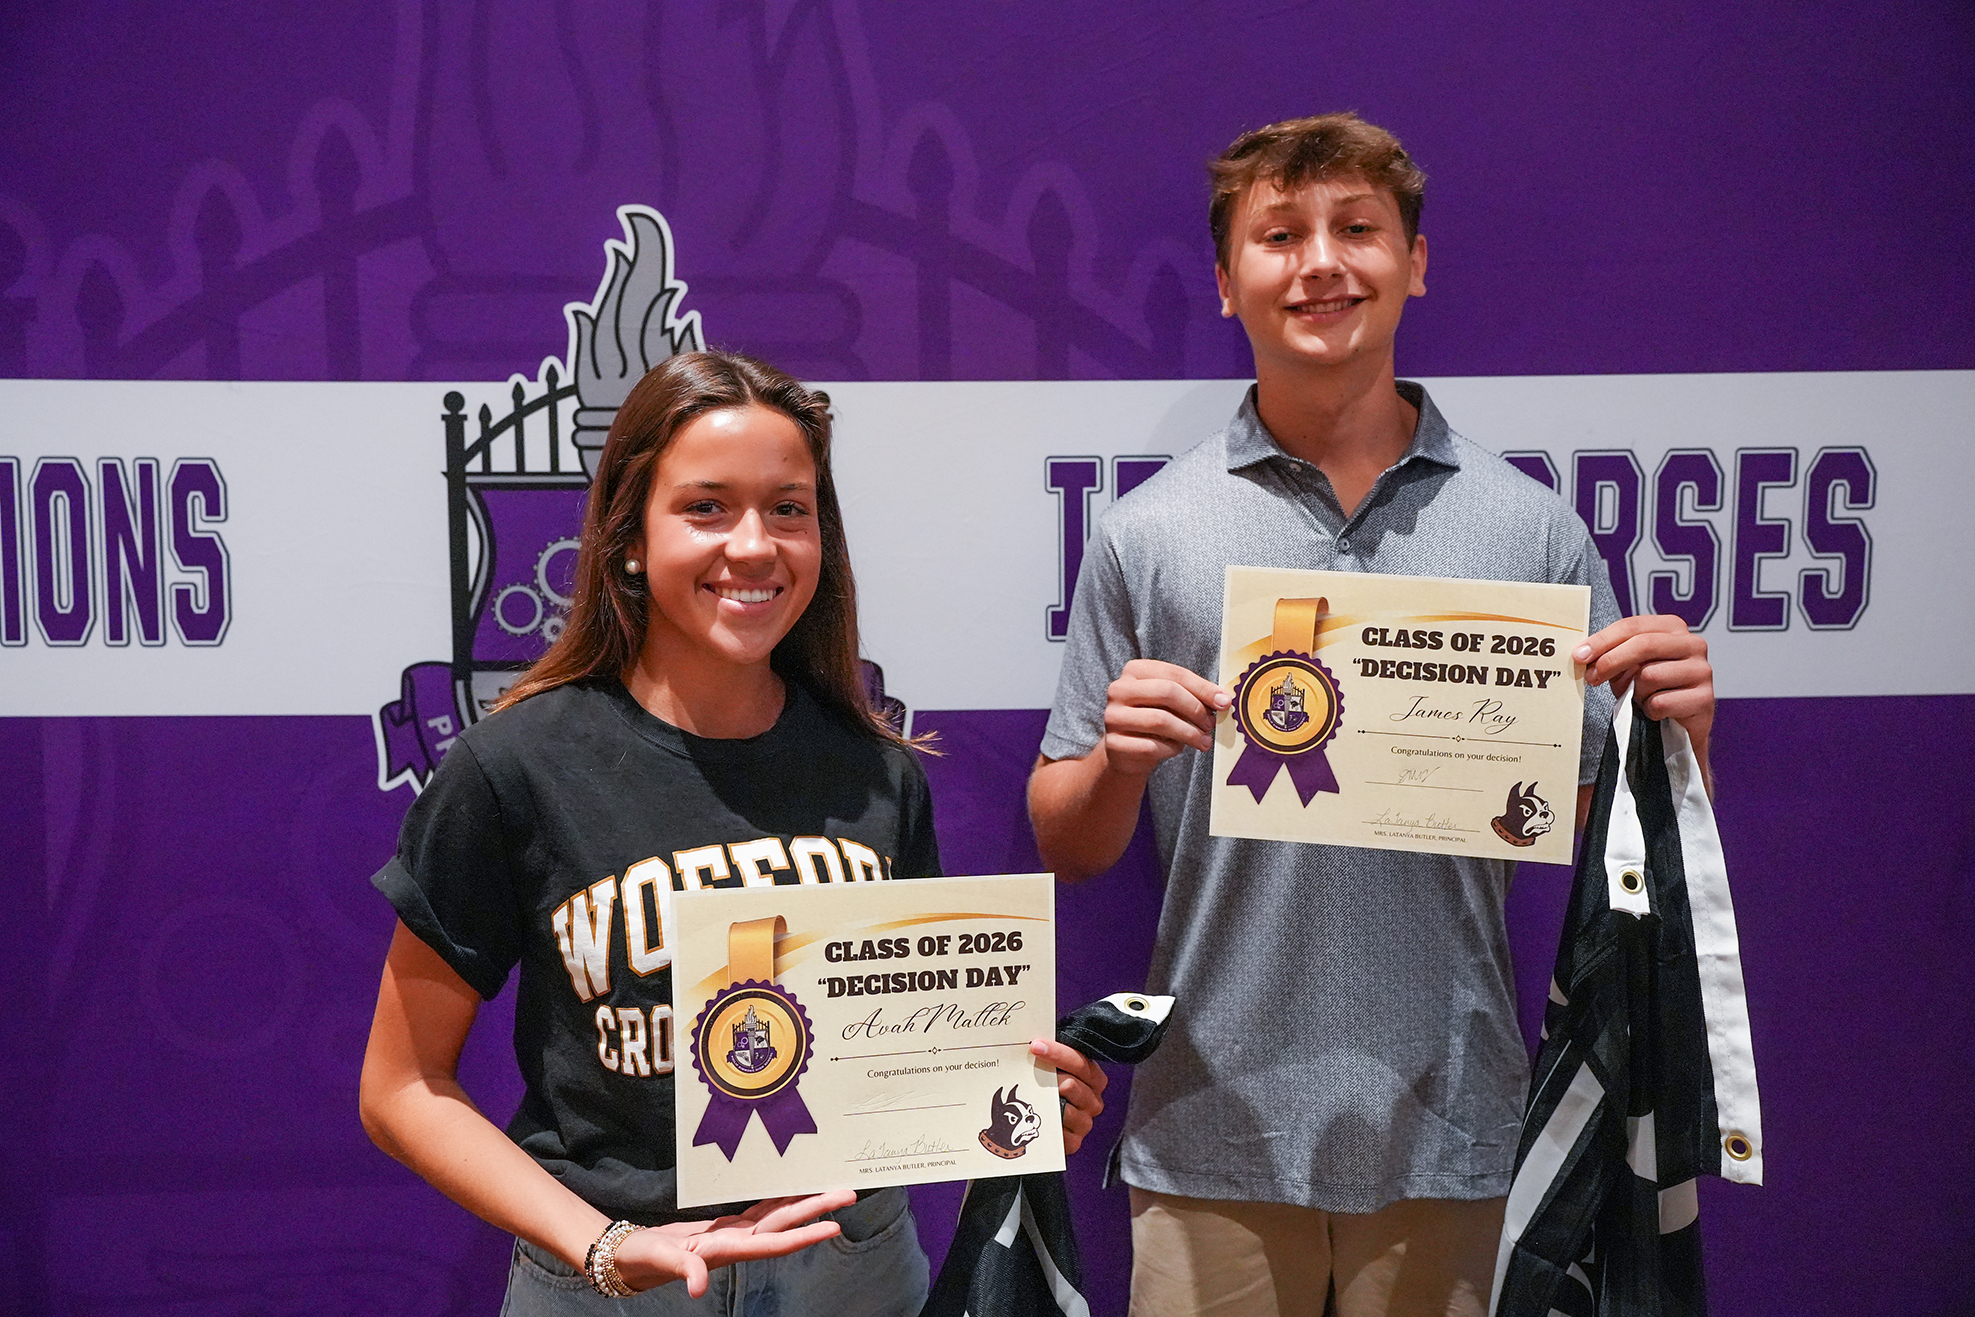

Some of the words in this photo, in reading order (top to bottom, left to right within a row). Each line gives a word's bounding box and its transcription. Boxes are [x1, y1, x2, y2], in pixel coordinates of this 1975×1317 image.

[0, 456, 232, 647] IONS
[1362, 627, 1443, 650] CLASS
[1450, 633, 1484, 652] OF
[1490, 635, 1555, 657] 2026
[1353, 657, 1488, 685] “DECISION
[1495, 668, 1561, 688] DAY”
[1389, 695, 1464, 722] James
[1468, 698, 1519, 735] Ray
[1391, 746, 1453, 758] Congratulations
[1454, 752, 1465, 760] on
[1466, 752, 1484, 762] your
[1486, 753, 1522, 764] decision!
[1389, 831, 1415, 839] LATANYA
[1438, 835, 1467, 843] PRINCIPAL
[824, 937, 910, 963] CLASS
[917, 935, 951, 957] OF
[958, 931, 1023, 954] 2026
[817, 968, 958, 998] “DECISION
[965, 964, 1031, 988] DAY”
[842, 1007, 931, 1040] Avah
[923, 1000, 1026, 1034] Mallek
[595, 1003, 674, 1079] CRO
[867, 1065, 930, 1079] Congratulations
[932, 1063, 943, 1074] on
[945, 1062, 963, 1075] your
[964, 1059, 1000, 1071] decision!
[875, 1165, 902, 1174] LATANYA
[927, 1159, 957, 1168] PRINCIPAL
